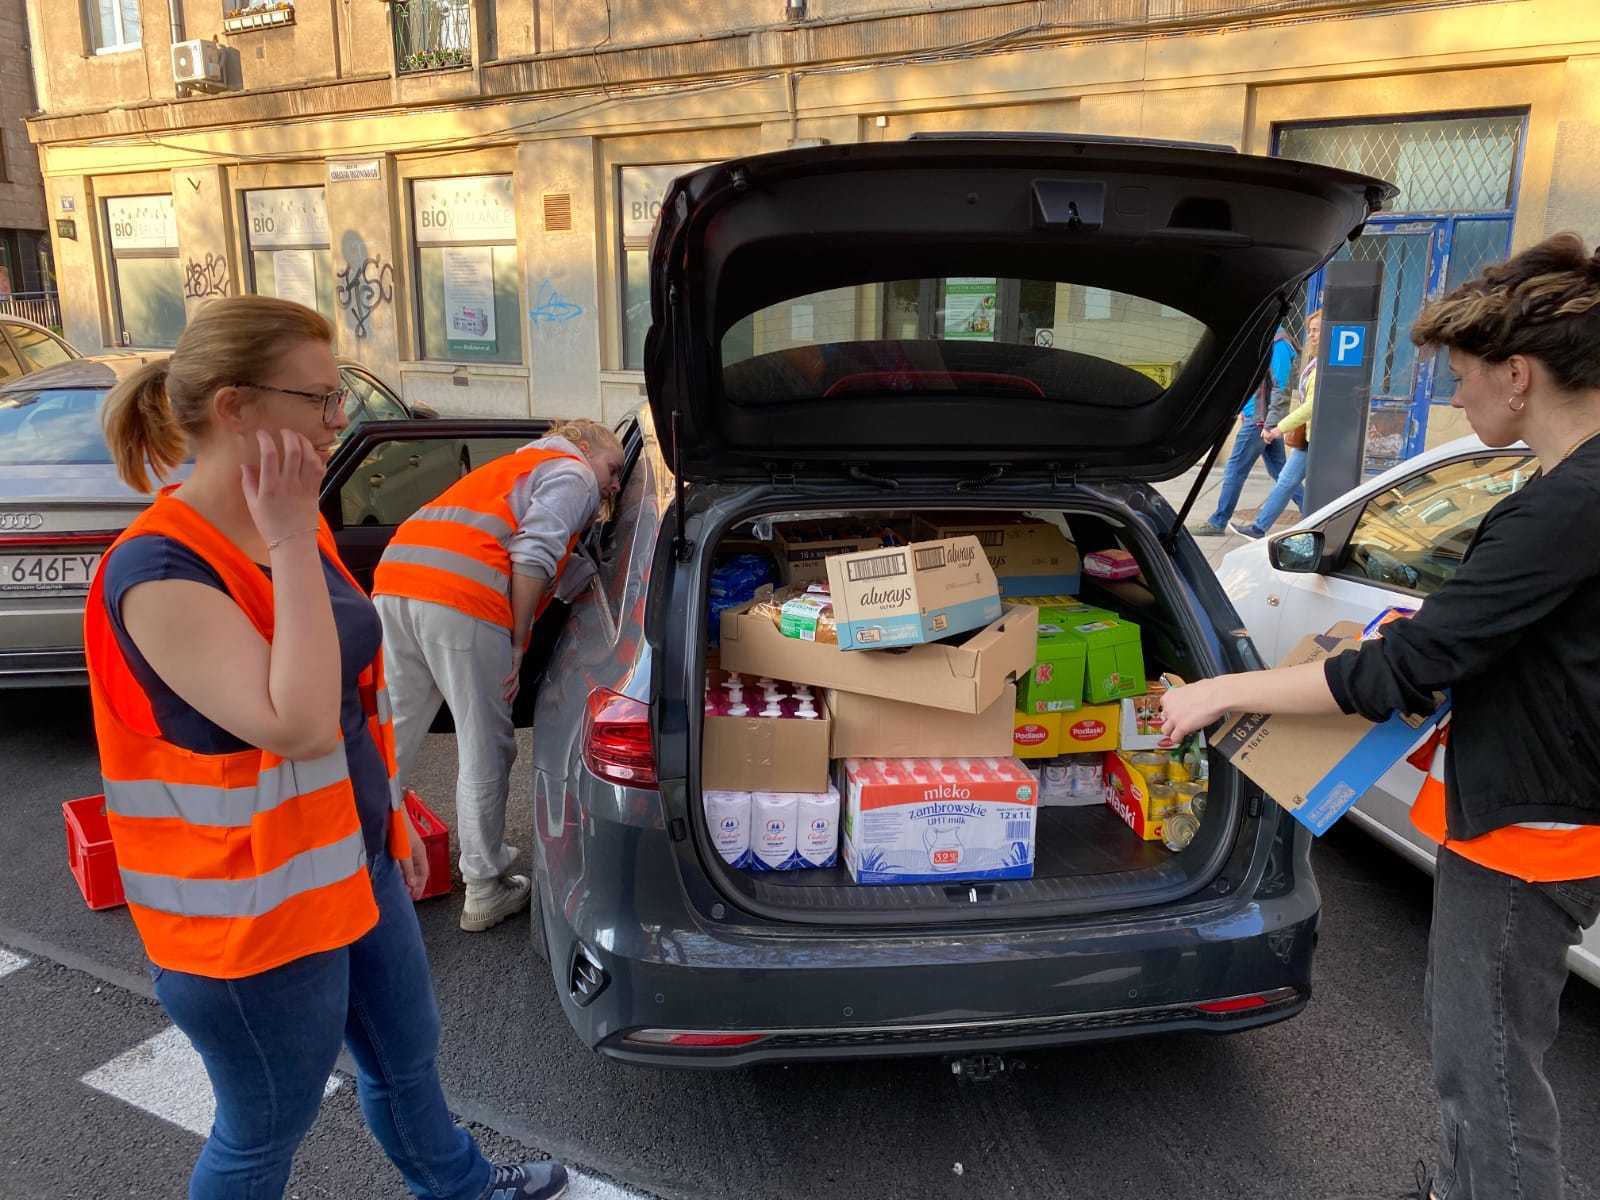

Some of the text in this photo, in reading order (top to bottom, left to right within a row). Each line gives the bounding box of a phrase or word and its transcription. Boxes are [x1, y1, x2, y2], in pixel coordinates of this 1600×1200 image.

[1337, 330, 1360, 361] P
[946, 543, 975, 567] always
[11, 557, 95, 582] 646FY
[860, 586, 912, 608] always
[1069, 726, 1104, 736] Podlaski
[1232, 727, 1247, 742] 16
[924, 783, 971, 801] mleko
[1000, 811, 1011, 820] 12
[1105, 784, 1136, 829] dlaski
